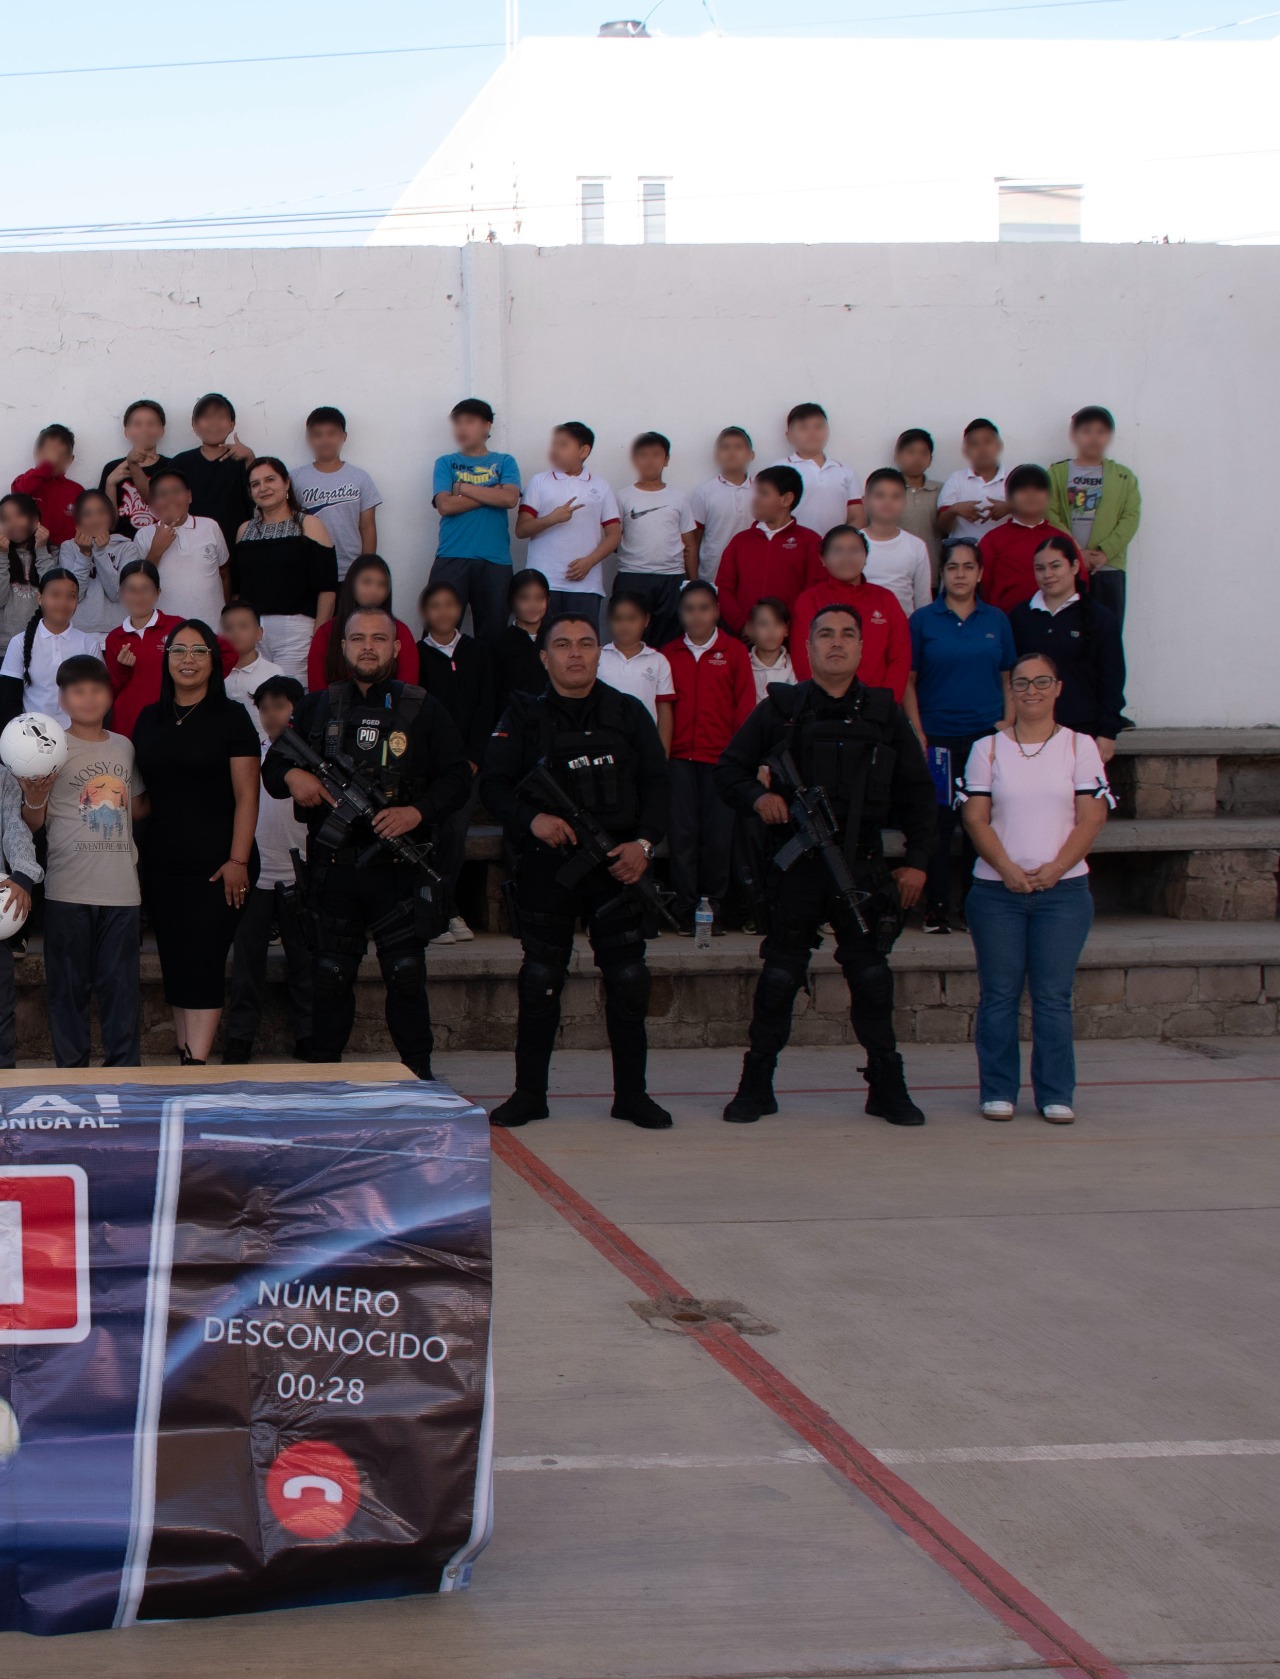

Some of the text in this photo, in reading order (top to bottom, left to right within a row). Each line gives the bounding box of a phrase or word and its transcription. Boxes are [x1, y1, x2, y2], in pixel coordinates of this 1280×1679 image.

[302, 483, 361, 503] Mazatlán
[1073, 476, 1103, 486] QUEEN
[360, 729, 376, 742] PID
[68, 761, 111, 791] MOSSY
[257, 1279, 400, 1317] NÚMERO
[203, 1316, 448, 1363] DESCONOCIDO
[276, 1371, 365, 1405] 00:28
